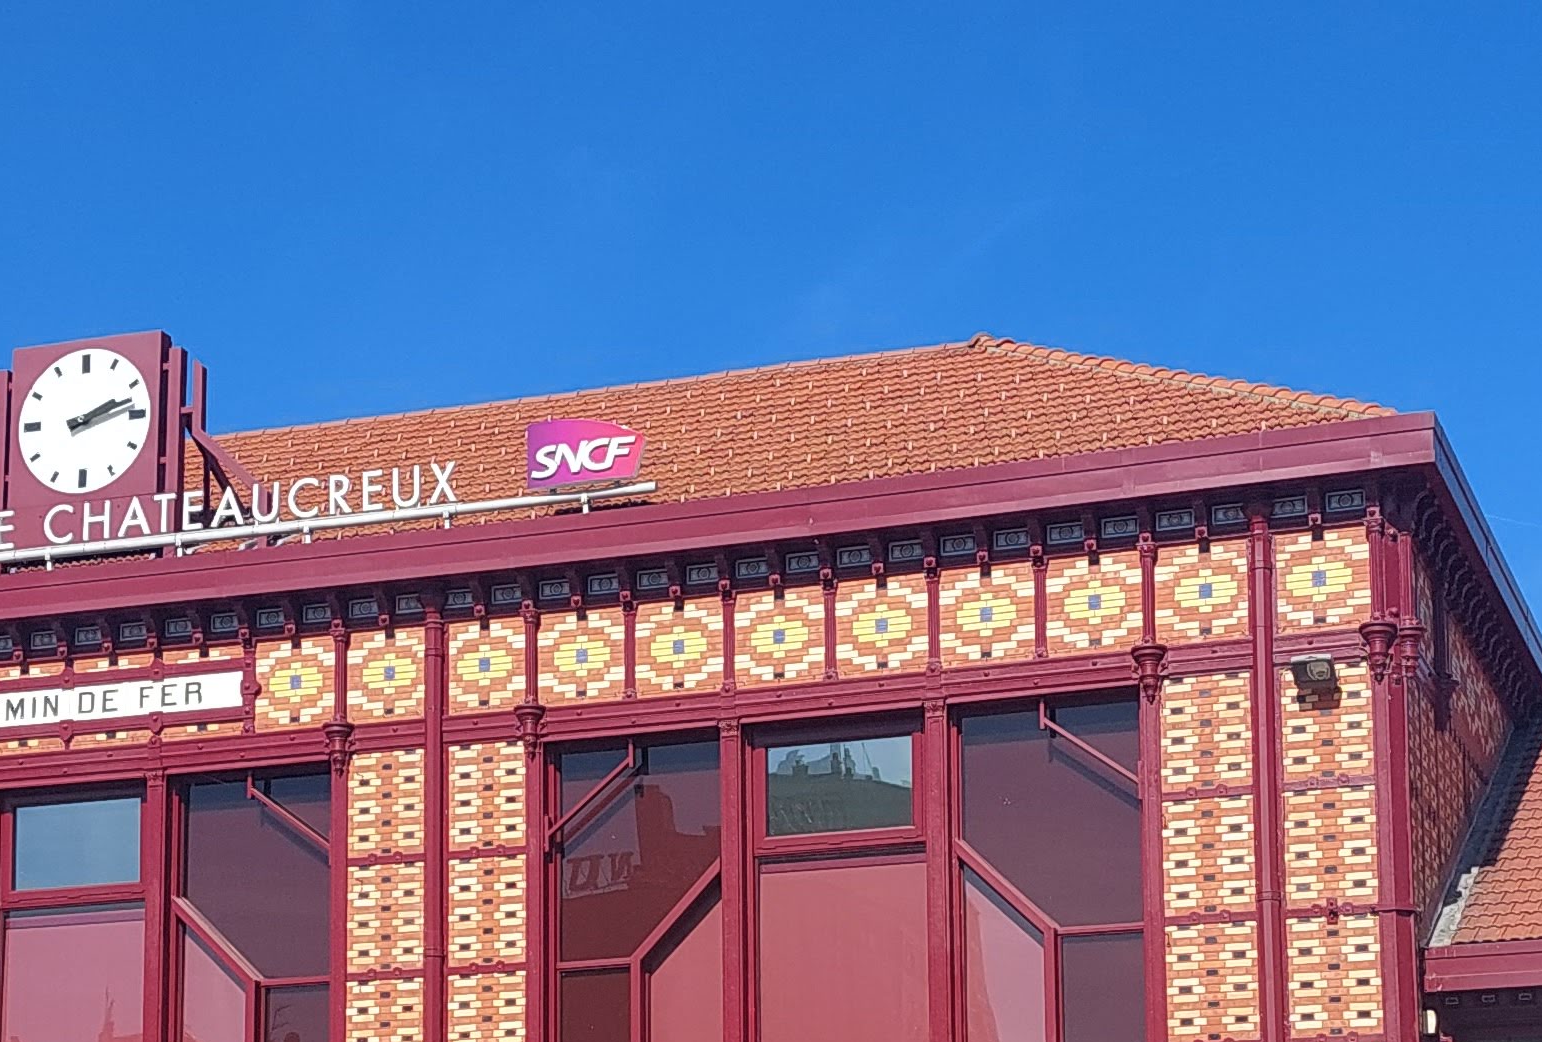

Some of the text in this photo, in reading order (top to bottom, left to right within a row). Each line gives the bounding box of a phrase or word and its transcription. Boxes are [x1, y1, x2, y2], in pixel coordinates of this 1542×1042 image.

[530, 435, 636, 480] SNCF
[43, 461, 457, 545] CHATEAUCREUX
[77, 689, 119, 714] DE
[139, 681, 203, 709] FER
